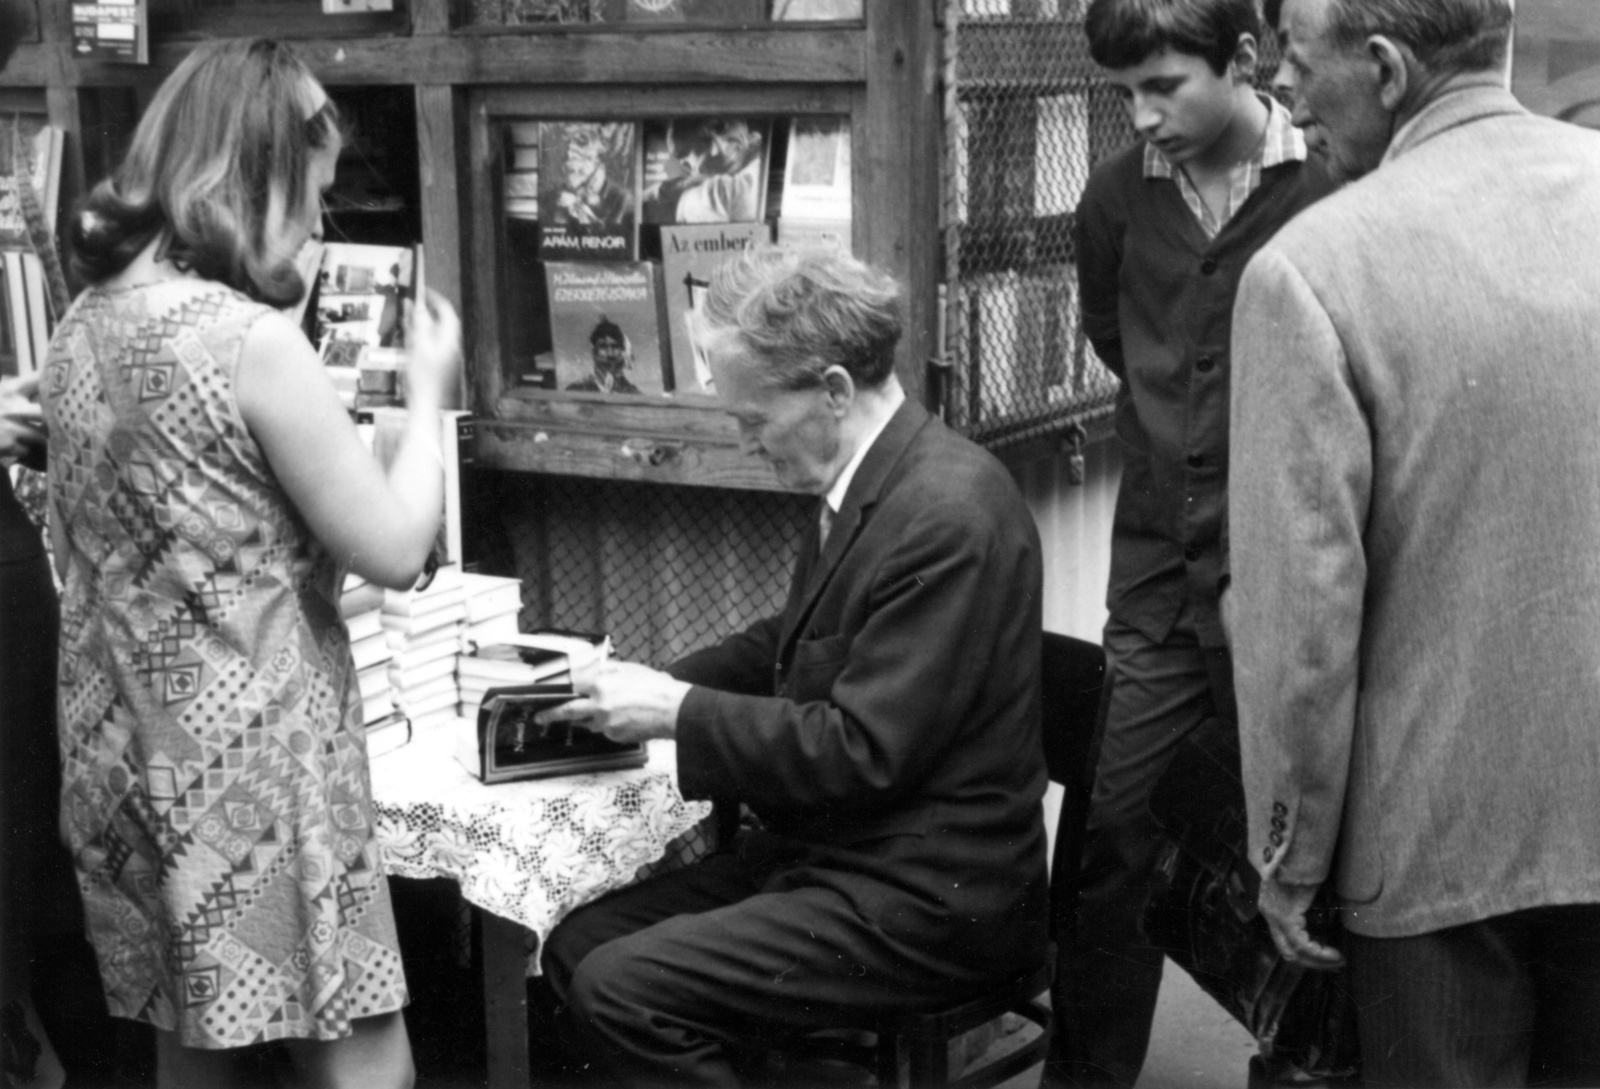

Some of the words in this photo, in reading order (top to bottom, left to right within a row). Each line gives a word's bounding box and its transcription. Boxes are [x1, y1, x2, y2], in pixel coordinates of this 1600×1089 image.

[74, 5, 136, 17] BUDAPEST
[581, 235, 627, 250] RENOIR
[668, 232, 690, 253] Az
